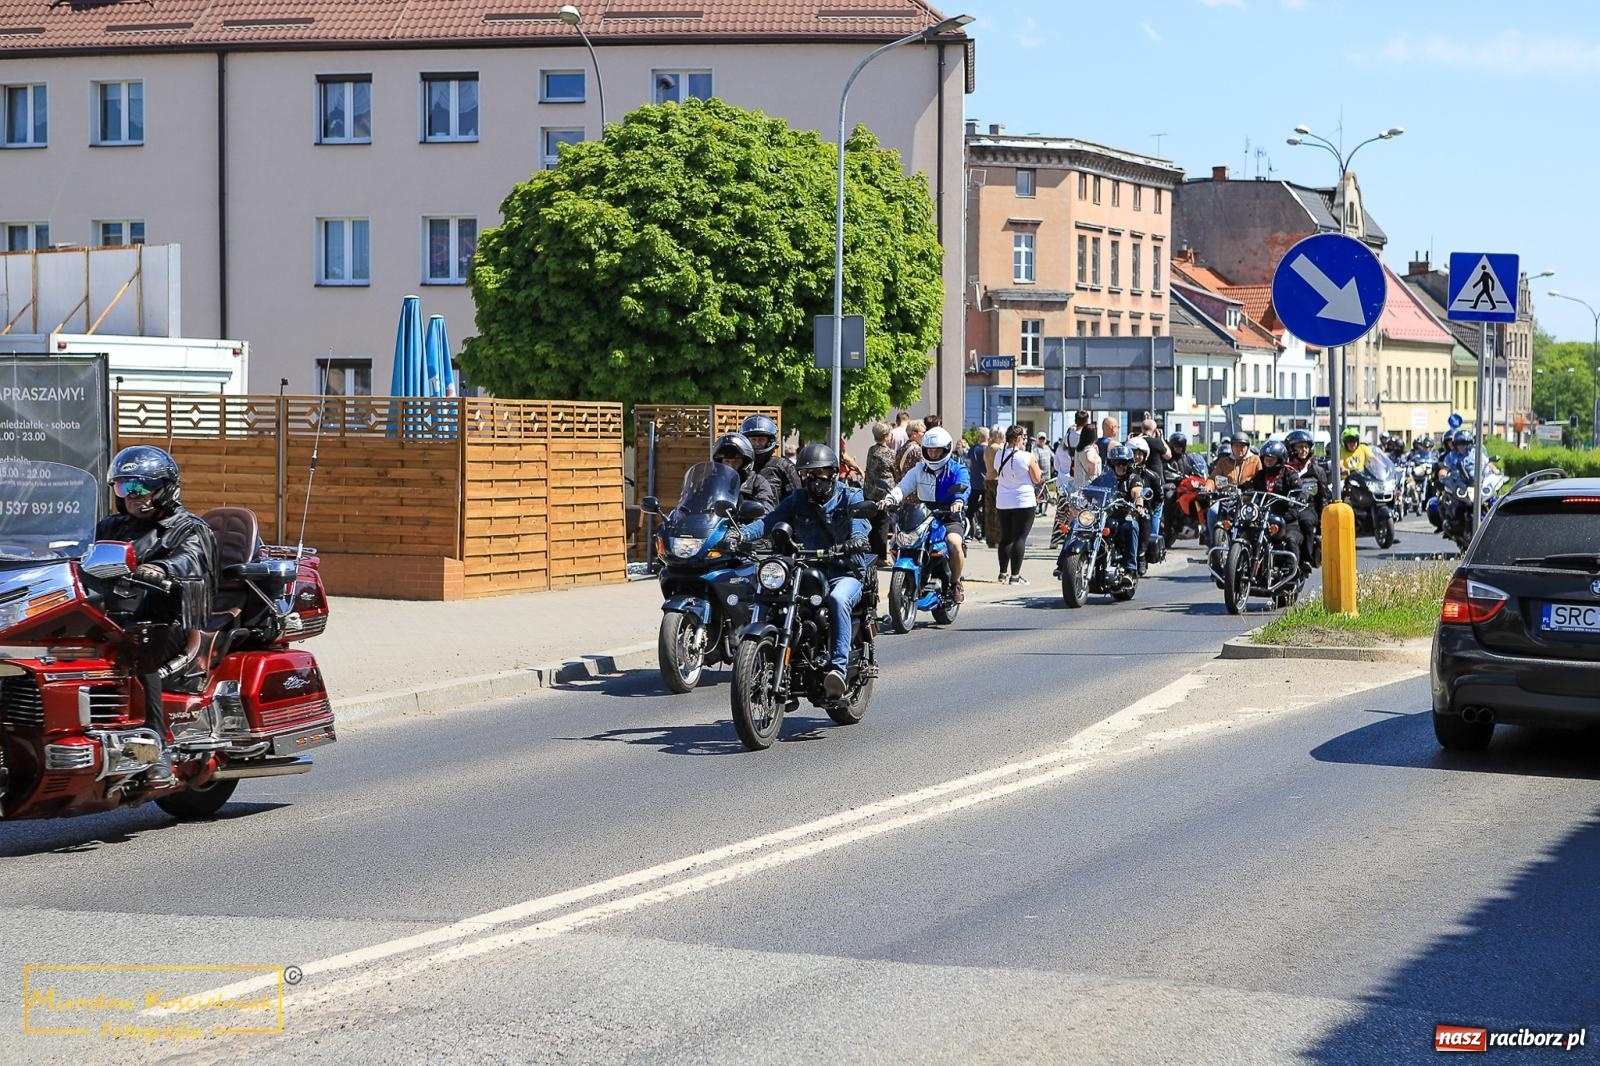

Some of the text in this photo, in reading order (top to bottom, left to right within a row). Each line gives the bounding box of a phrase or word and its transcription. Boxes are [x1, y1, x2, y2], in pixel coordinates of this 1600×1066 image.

[0, 387, 85, 401] PRASZAMY!
[0, 419, 44, 430] niedziałek
[51, 420, 80, 430] sobota
[0, 431, 15, 441] .00
[22, 431, 46, 441] 23.00
[27, 468, 51, 479] 22.00
[5, 500, 80, 515] 537 891 962
[1554, 606, 1596, 626] SRC
